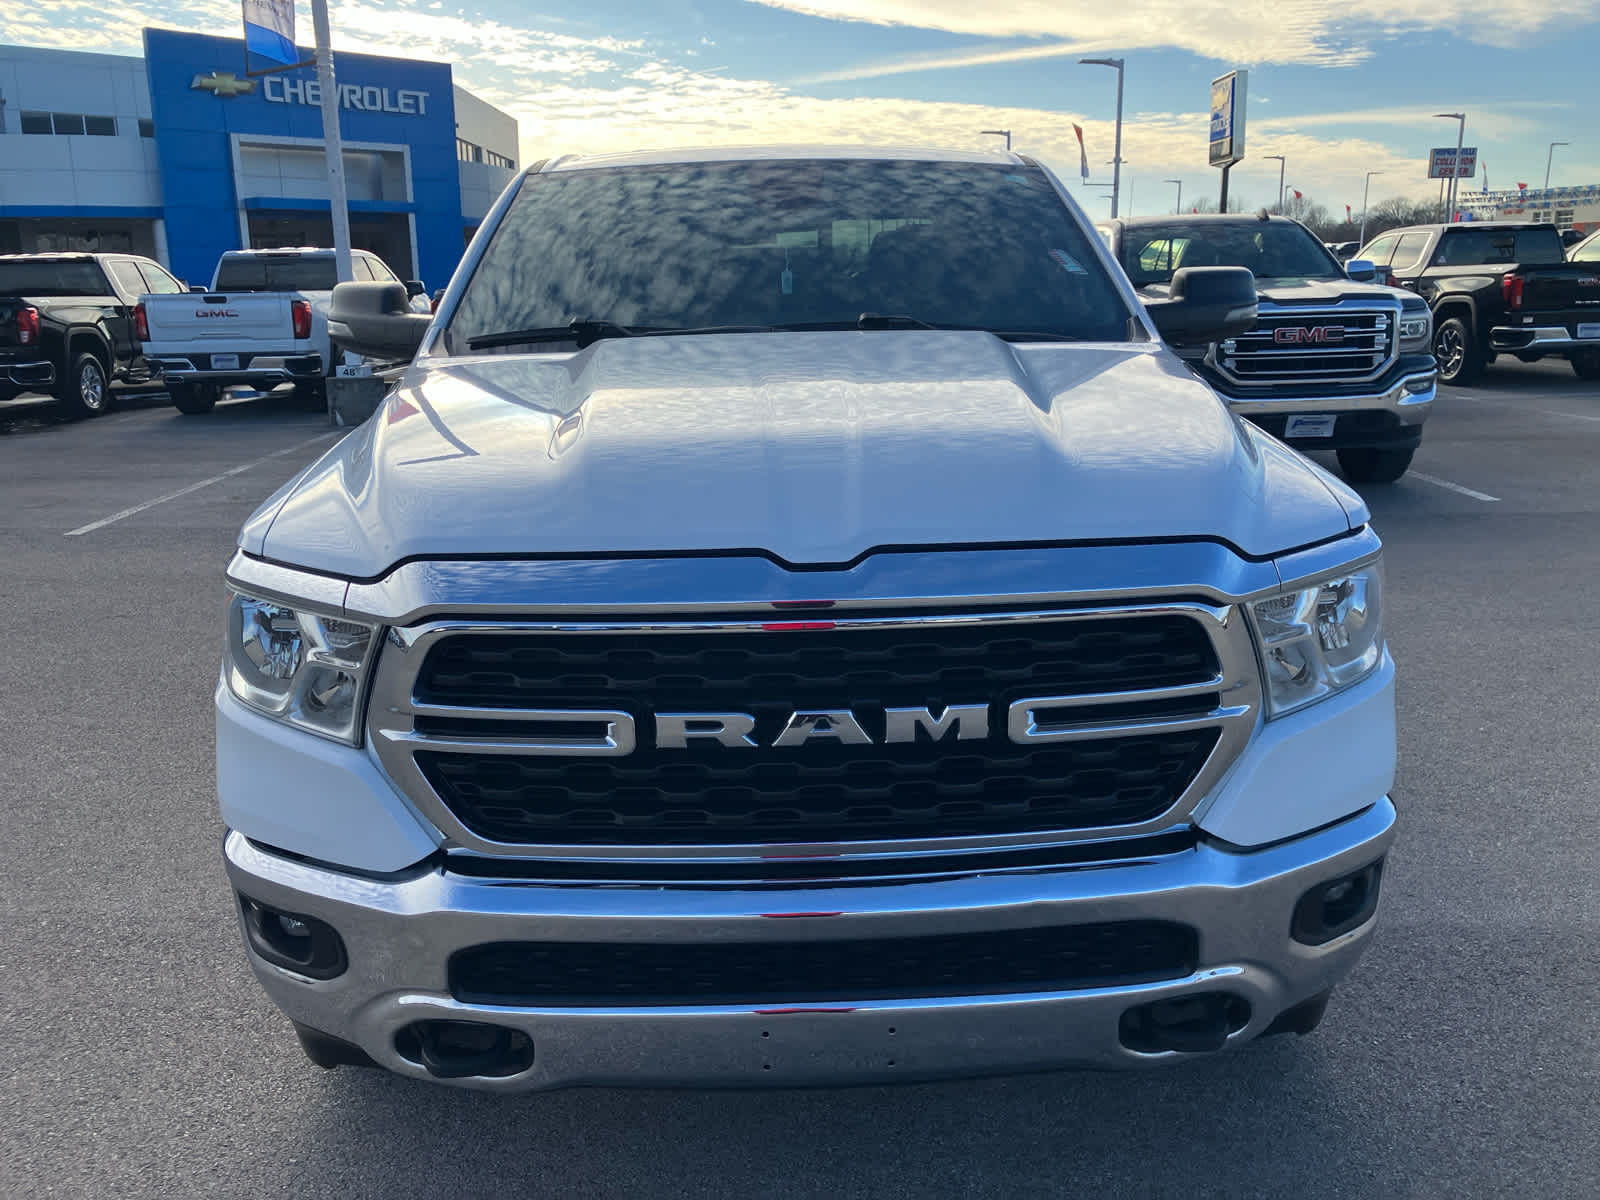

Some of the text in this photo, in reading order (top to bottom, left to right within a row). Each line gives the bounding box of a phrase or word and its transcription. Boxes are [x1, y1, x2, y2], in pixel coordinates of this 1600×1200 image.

[1438, 167, 1469, 176] CENER
[195, 309, 240, 318] GMC
[1274, 325, 1345, 343] GMC
[654, 703, 989, 749] RAM
